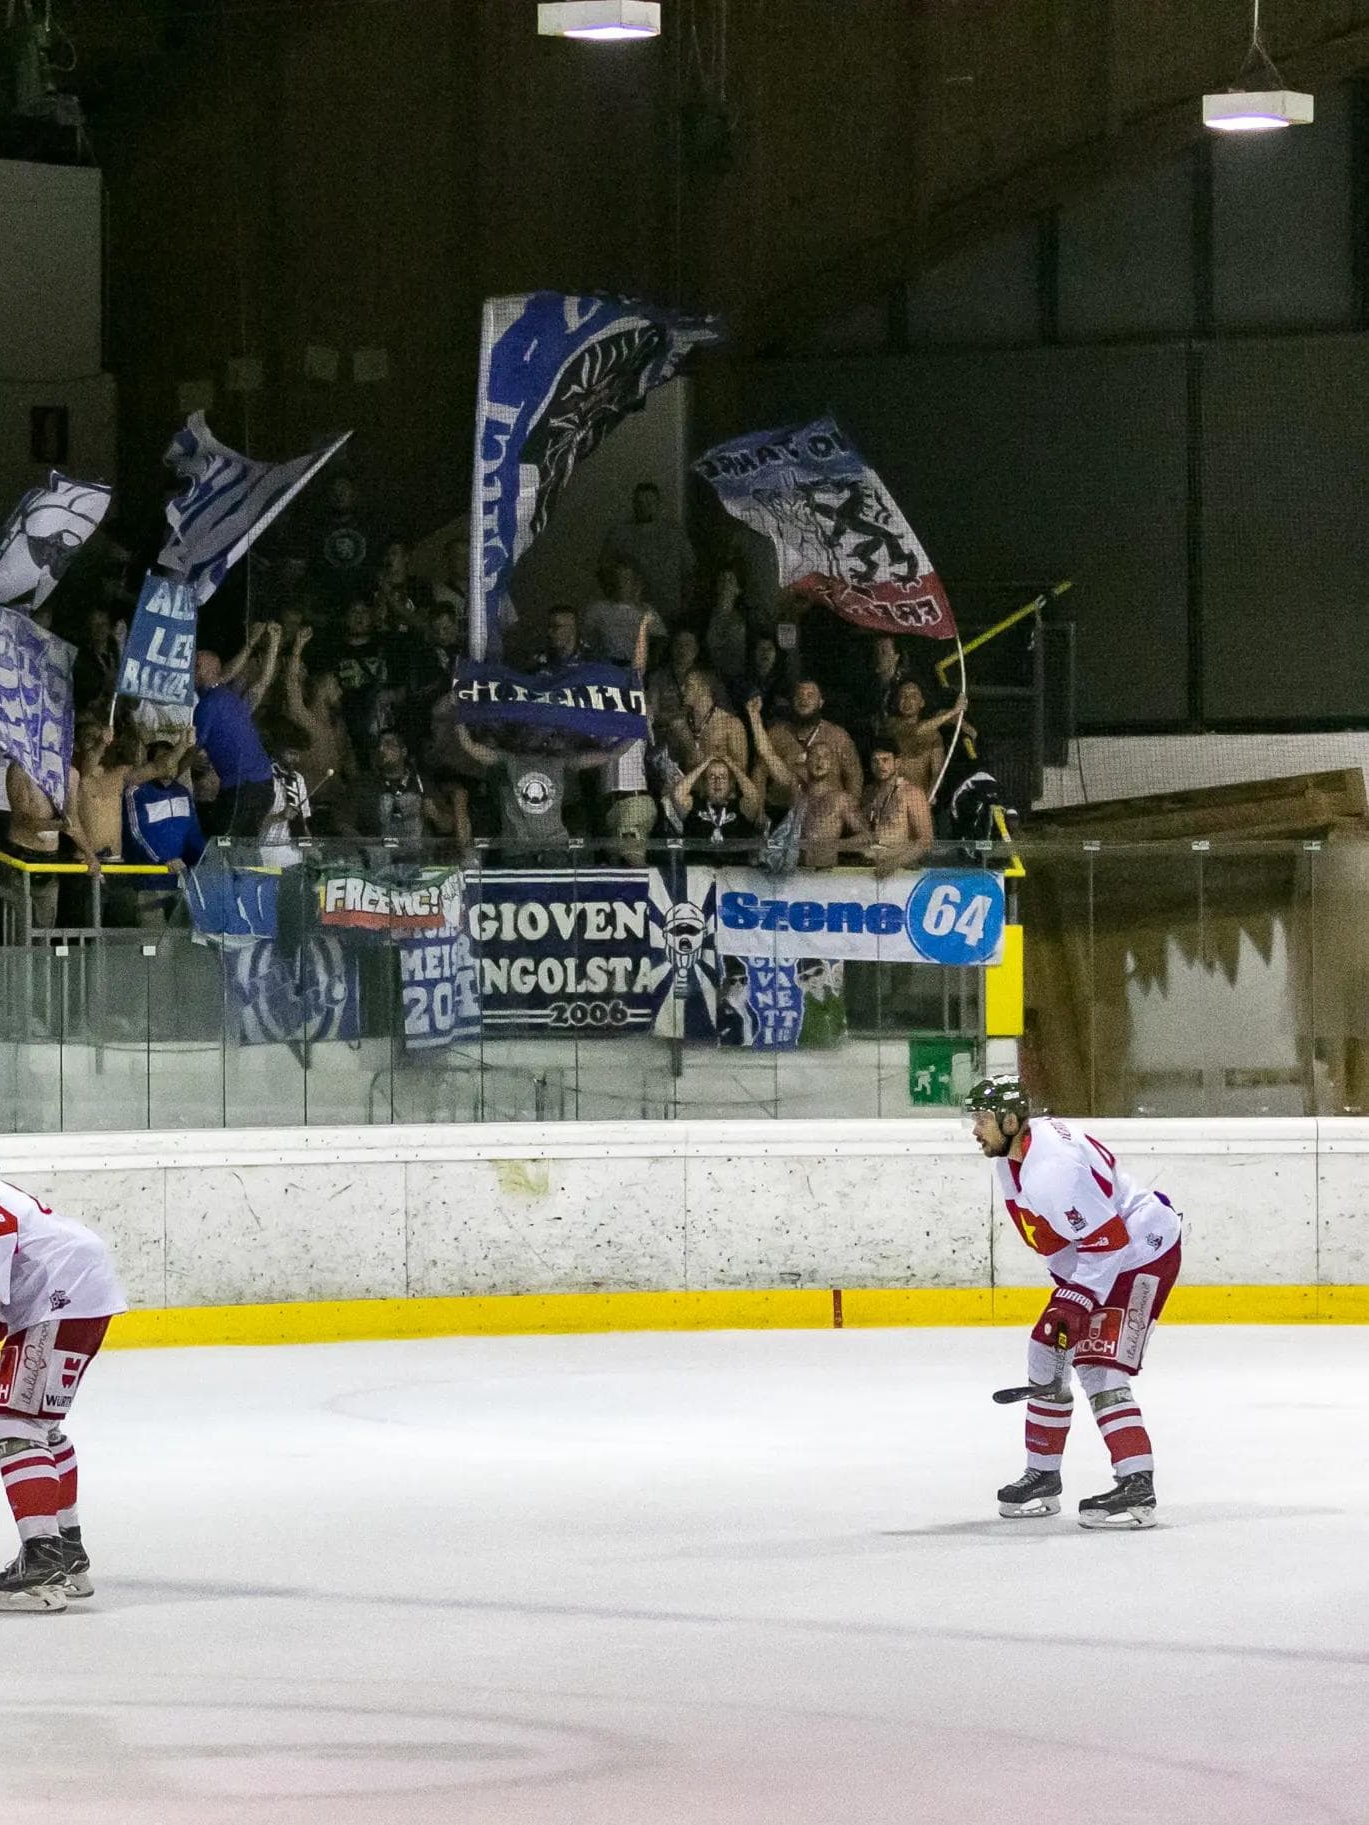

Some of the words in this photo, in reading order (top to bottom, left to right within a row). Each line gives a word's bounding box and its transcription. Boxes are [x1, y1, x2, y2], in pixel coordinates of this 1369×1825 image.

[468, 901, 650, 941] GIOVEN
[718, 891, 908, 935] Szene
[921, 884, 993, 947] 64
[480, 956, 655, 995] NGOLSTA
[546, 1000, 631, 1027] 2006
[1054, 1287, 1095, 1313] WARR
